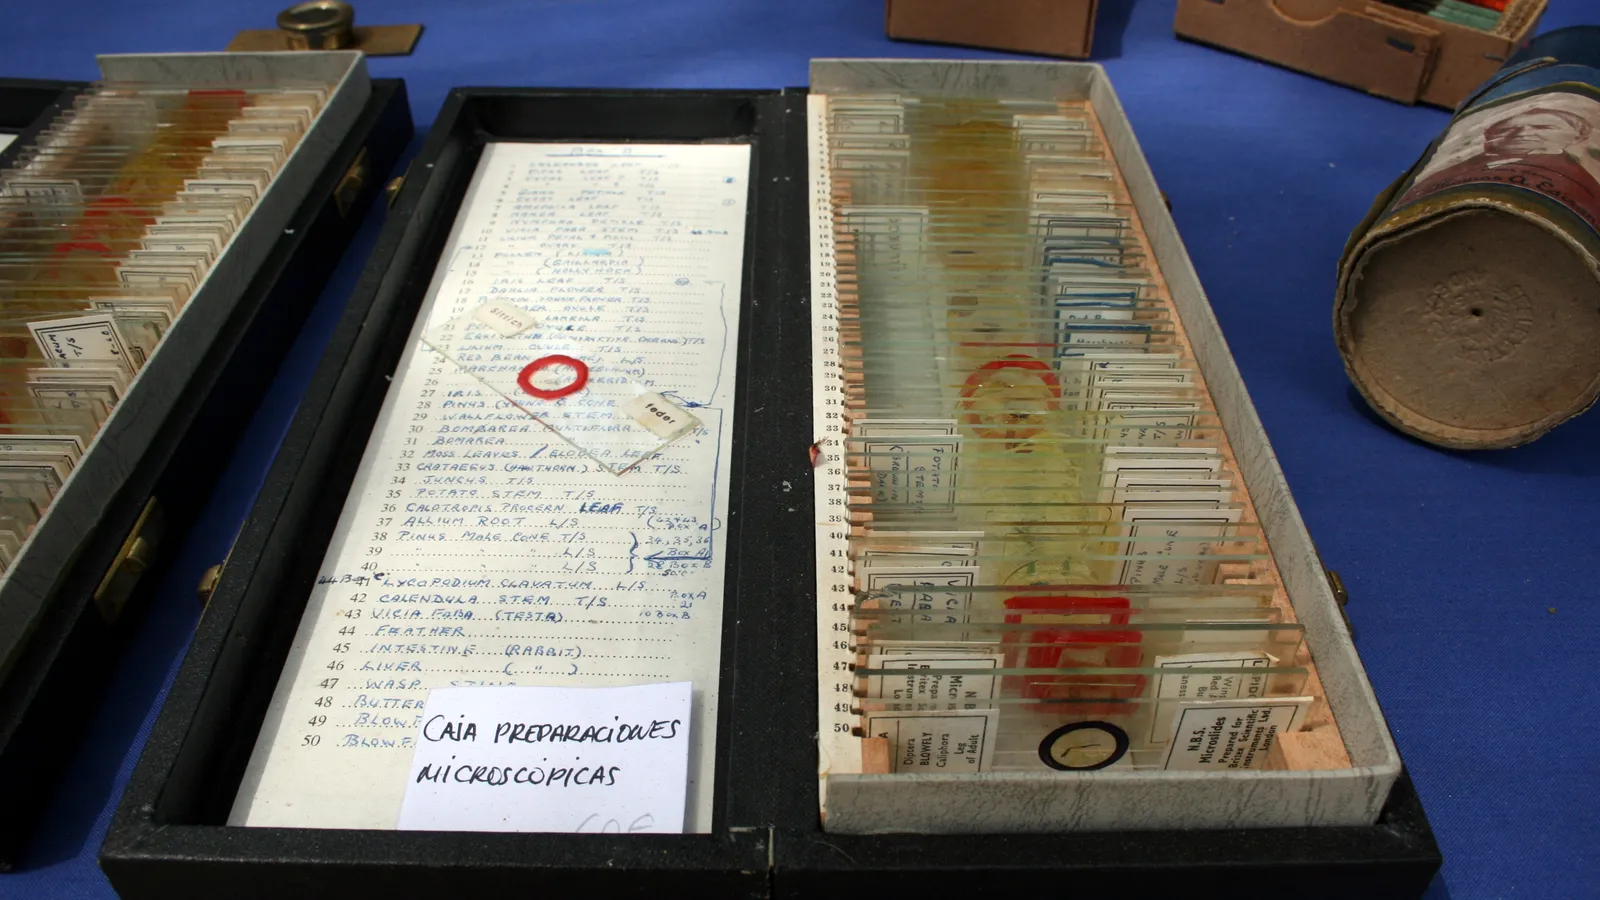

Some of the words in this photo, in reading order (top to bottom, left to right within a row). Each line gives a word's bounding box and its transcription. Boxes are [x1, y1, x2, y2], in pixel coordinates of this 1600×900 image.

[416, 401, 431, 409] 28
[401, 450, 414, 458] 32
[464, 450, 519, 458] LEAVES
[656, 464, 681, 474] T/S
[392, 476, 406, 485] 34
[423, 476, 486, 485] JUNCUS
[508, 477, 533, 486] T/S
[387, 490, 401, 498] 35
[416, 488, 477, 498] POTATO
[493, 490, 542, 499] STEM
[565, 490, 595, 500] T/S
[382, 503, 396, 512] 36
[635, 505, 657, 518] T/S
[376, 518, 392, 527] 37
[400, 516, 464, 527] ALLIUM
[478, 516, 526, 526] ROOT
[550, 518, 579, 528] L/S
[373, 532, 388, 541] 38
[397, 532, 445, 542] PINUS
[464, 532, 500, 542] MALE
[513, 532, 549, 541] CONE
[562, 533, 586, 544] T/S
[367, 546, 382, 556] 39
[563, 548, 595, 559] L/S
[361, 561, 378, 572] 40
[563, 562, 597, 572] L/S
[382, 577, 491, 589] LYCOPODIUM
[500, 579, 592, 590] CLAVATUM
[616, 581, 646, 592] L/S
[350, 593, 367, 603] 42
[379, 594, 477, 604] CALENDULA
[499, 594, 550, 606] STEM
[576, 595, 607, 609] T/S
[345, 609, 361, 619] 43
[371, 608, 420, 620] VICIA
[432, 609, 472, 620] FABA
[496, 609, 563, 623] (TESTA)
[338, 626, 355, 636] 44
[375, 625, 465, 637] FEATHER
[333, 643, 351, 653] 45
[370, 643, 477, 657] INTESTINE
[505, 644, 582, 659] (RABBIT)
[327, 660, 344, 671] 46
[360, 660, 422, 672] LIVER
[320, 678, 339, 689] 47
[366, 679, 421, 690] WASP
[315, 697, 333, 708] 48
[354, 696, 425, 710] BUTTER
[834, 704, 849, 712] 49
[308, 715, 327, 726] 49
[1258, 708, 1272, 723] Ltd.
[424, 714, 477, 743] CAJA
[494, 716, 681, 744] PREPARACIONES
[834, 724, 849, 732] 50
[301, 735, 320, 746] 50
[967, 734, 979, 754] Adult
[1187, 727, 1206, 752] N.B.S.
[1198, 716, 1226, 764] Microslides
[1218, 731, 1238, 764] Prepared
[1231, 717, 1244, 729] for
[1228, 747, 1244, 768] Britex
[1238, 709, 1259, 743] Scientific
[1258, 724, 1278, 752] London
[904, 738, 915, 765] Diptera
[920, 732, 933, 766] BLOWFLY
[936, 733, 950, 768] Caliphora
[954, 742, 967, 755] Leg
